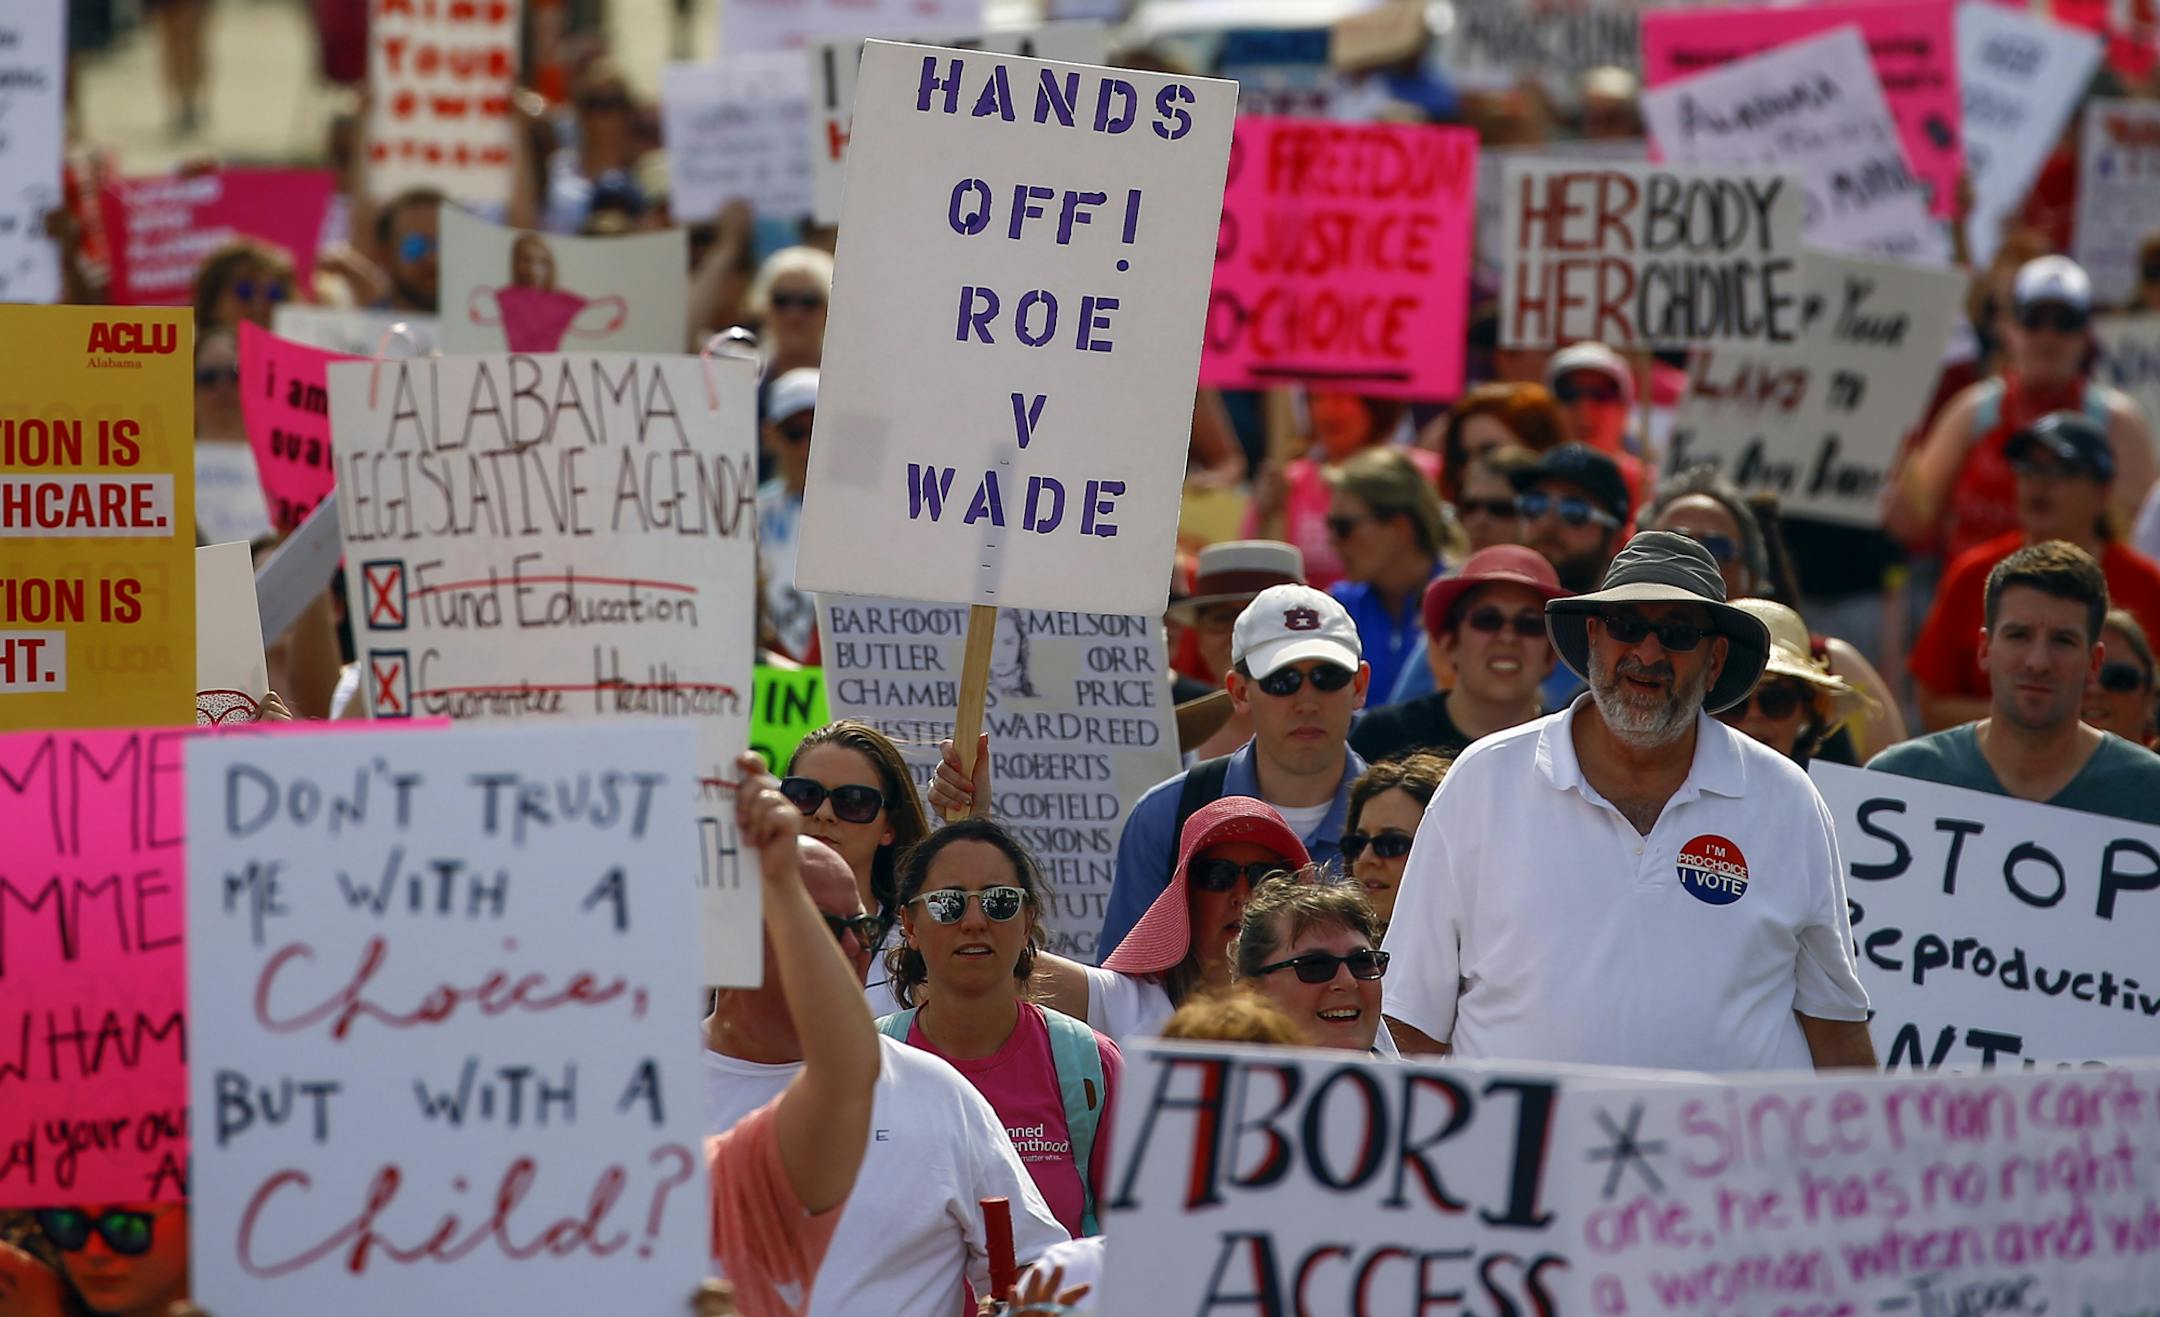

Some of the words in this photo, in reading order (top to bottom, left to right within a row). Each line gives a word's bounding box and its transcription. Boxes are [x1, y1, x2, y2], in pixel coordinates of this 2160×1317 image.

[915, 55, 1197, 141] HANDS
[1266, 127, 1472, 200] FREEDOM
[947, 177, 1143, 273] OFF!
[1250, 212, 1438, 275] JUSTICE
[1519, 171, 1639, 252] HER
[1643, 173, 1785, 253] BODY
[955, 285, 1121, 354] ROE
[1250, 287, 1419, 359] CHOICE
[1513, 257, 1637, 347] HER
[1637, 259, 1794, 344] CHOICE
[87, 323, 177, 354] ACLU
[87, 358, 142, 369] Alabama
[387, 356, 690, 451] ALABAMA
[1010, 392, 1048, 449] V
[0, 420, 82, 467] ION
[99, 420, 140, 467] IS
[2, 483, 167, 528] HCARE.
[336, 446, 595, 542] LEGISLATIVE
[611, 446, 758, 541] AGENDA
[906, 462, 1127, 538] WADE
[0, 579, 84, 623] ION
[100, 579, 142, 623] IS
[414, 560, 501, 628] Fund
[513, 554, 698, 629] Education
[830, 606, 967, 635] BARFOOT
[1028, 611, 1147, 637] MELSON
[594, 646, 743, 717] Healthcare
[836, 642, 945, 671] BUTLER
[1088, 646, 1156, 673] ORR
[1076, 680, 1156, 707] PRICE
[985, 712, 1082, 741] WARD
[1085, 716, 1160, 747] REED
[992, 752, 1111, 781] ROBERTS
[225, 756, 424, 840] DON'T
[468, 771, 666, 849] TRUST
[1677, 852, 1748, 878] PROCHOICE
[1681, 868, 1687, 883] I
[1695, 870, 1744, 896] VOTE
[1705, 844, 1726, 858] I'M
[1850, 797, 2160, 921] STOP
[222, 859, 291, 949] ME
[337, 846, 510, 919] WITH
[582, 866, 631, 935] A
[256, 936, 650, 1043] Choice,
[214, 1067, 342, 1148] BUT
[412, 1055, 580, 1131] WITH
[616, 1057, 666, 1128] A
[1006, 1122, 1044, 1138] nned
[44, 1116, 131, 1191] your
[1012, 1137, 1070, 1153] enthood
[236, 1143, 696, 1280] Child?
[1797, 1163, 1911, 1227] has
[1921, 1160, 1989, 1213] no
[1196, 1228, 1573, 1317] ACCESS
[1647, 1247, 1837, 1313] woman
